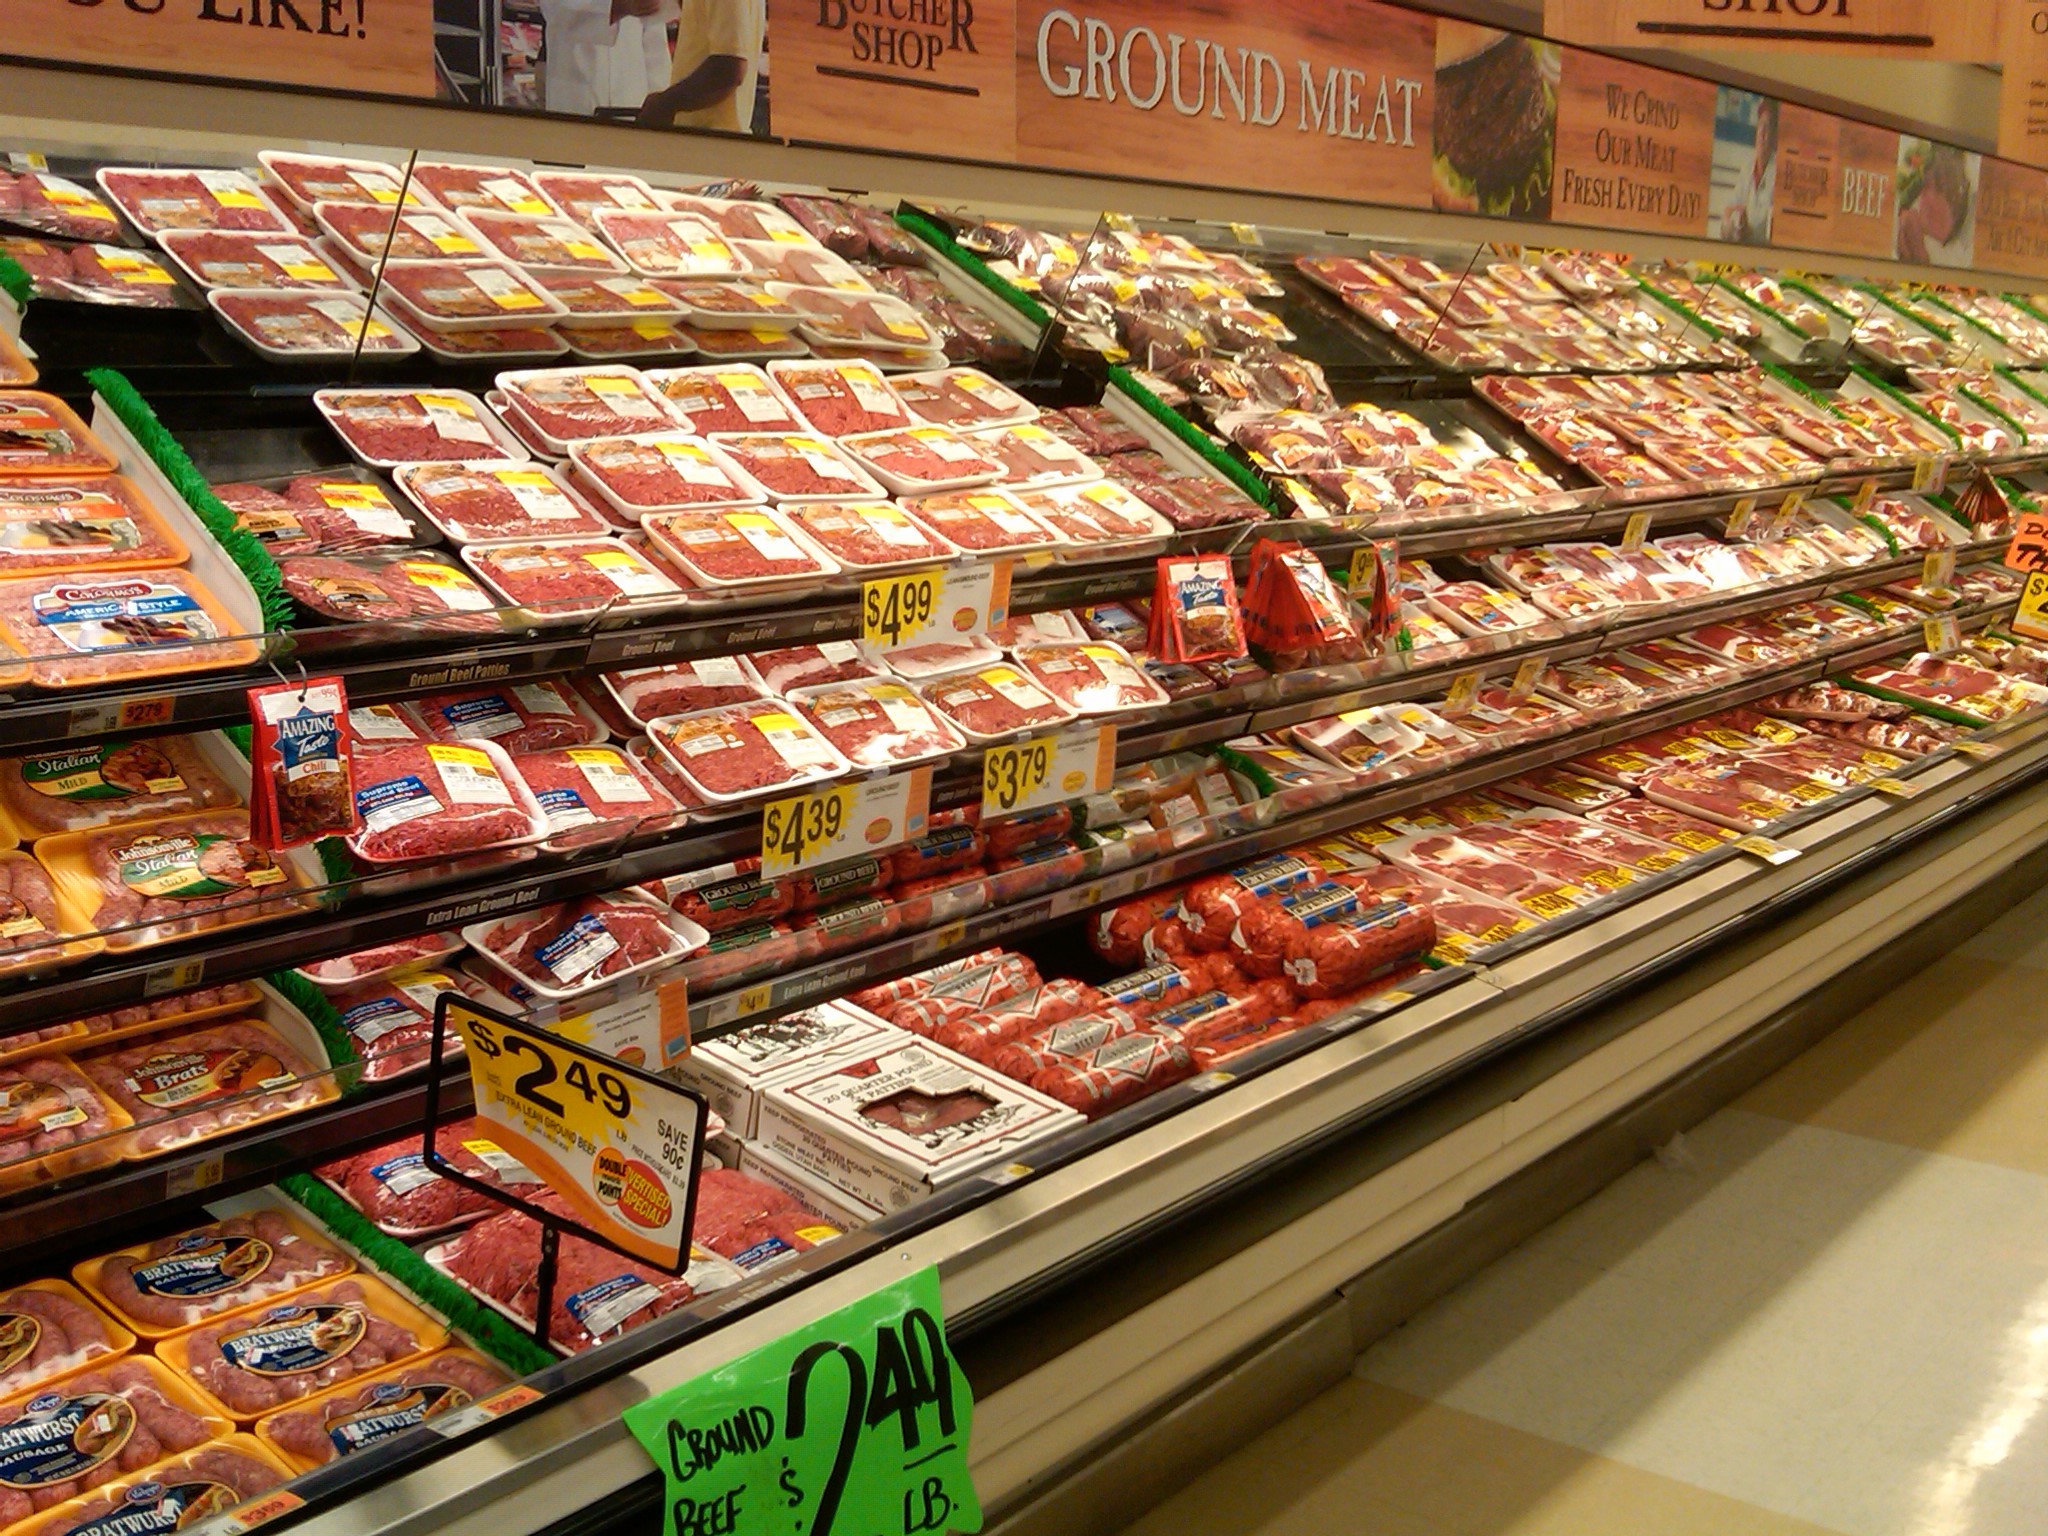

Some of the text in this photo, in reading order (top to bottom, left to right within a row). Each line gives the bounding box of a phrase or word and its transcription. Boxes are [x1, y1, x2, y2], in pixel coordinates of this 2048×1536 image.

[853, 21, 943, 71] SHOP
[1036, 9, 1422, 148] GROUND MEAT
[1606, 83, 1680, 130] WE GRIND
[1595, 128, 1677, 173] OUR MEAT
[1562, 168, 1613, 208] FRESH
[1616, 177, 1664, 214] EVERY
[1842, 167, 1889, 217] BEEF
[409, 669, 448, 688] Ground
[450, 664, 474, 682] Beef
[474, 661, 510, 679] Patties
[282, 714, 335, 739] AMAZING
[298, 734, 330, 757] Taste
[37, 753, 101, 776] Italian
[302, 760, 327, 774] Chili
[57, 776, 88, 792] MILD
[361, 781, 408, 798] Supreme
[538, 791, 568, 803] preme
[118, 836, 196, 862] Johnsonville
[135, 849, 199, 875] Italian
[705, 878, 748, 899] GROUND
[817, 863, 879, 889] GROUND BEEF
[426, 887, 540, 925] Extra Lean Ground Beef
[134, 1054, 207, 1079] Johnsonville
[153, 1063, 209, 1090] Brats
[842, 1074, 895, 1098] QUARTER
[868, 1076, 916, 1099] PATTIES
[496, 1091, 522, 1114] EXTRA
[544, 1117, 578, 1145] GROUND
[577, 1135, 598, 1157] BEEF
[657, 1119, 689, 1153] SAVE
[599, 1156, 628, 1178] DOUBLE
[662, 1142, 685, 1171] 90¢
[598, 1180, 622, 1200] POINTS
[627, 1166, 670, 1211] VERTISED
[622, 1190, 668, 1227] SPECIAL!
[0, 1412, 80, 1450] ATWURST
[340, 1403, 427, 1441] ATWURST
[667, 1404, 775, 1482] GROUND
[673, 1484, 747, 1536] BEEF
[903, 1476, 960, 1535] LB.
